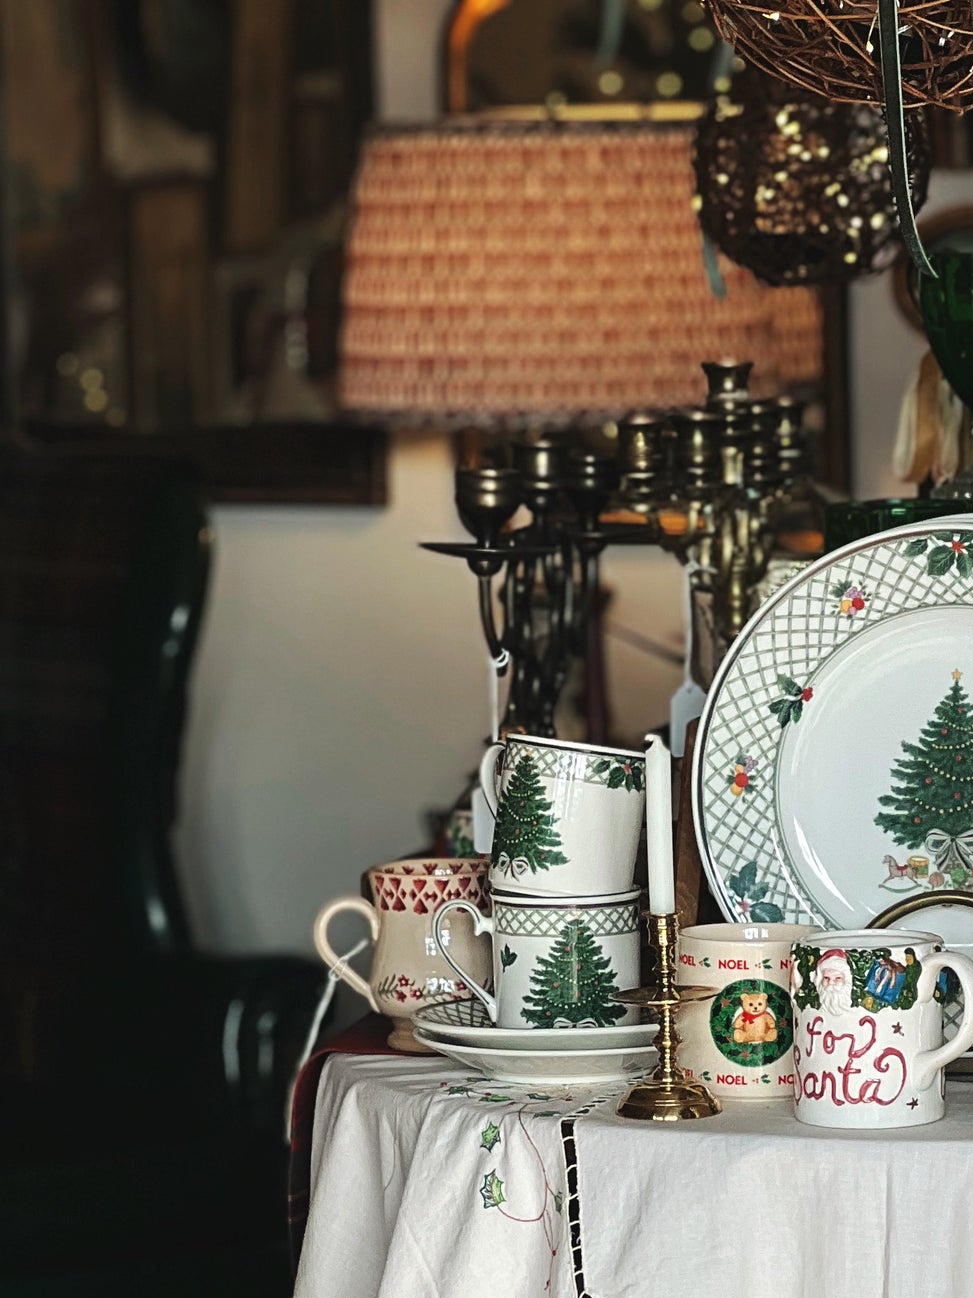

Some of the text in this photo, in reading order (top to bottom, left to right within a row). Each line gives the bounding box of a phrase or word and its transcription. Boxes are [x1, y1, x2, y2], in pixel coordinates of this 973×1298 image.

[718, 959, 749, 970] NOEL
[805, 1015, 876, 1058] for
[716, 1074, 794, 1085] NOEL NO
[793, 1047, 907, 1106] Santa
